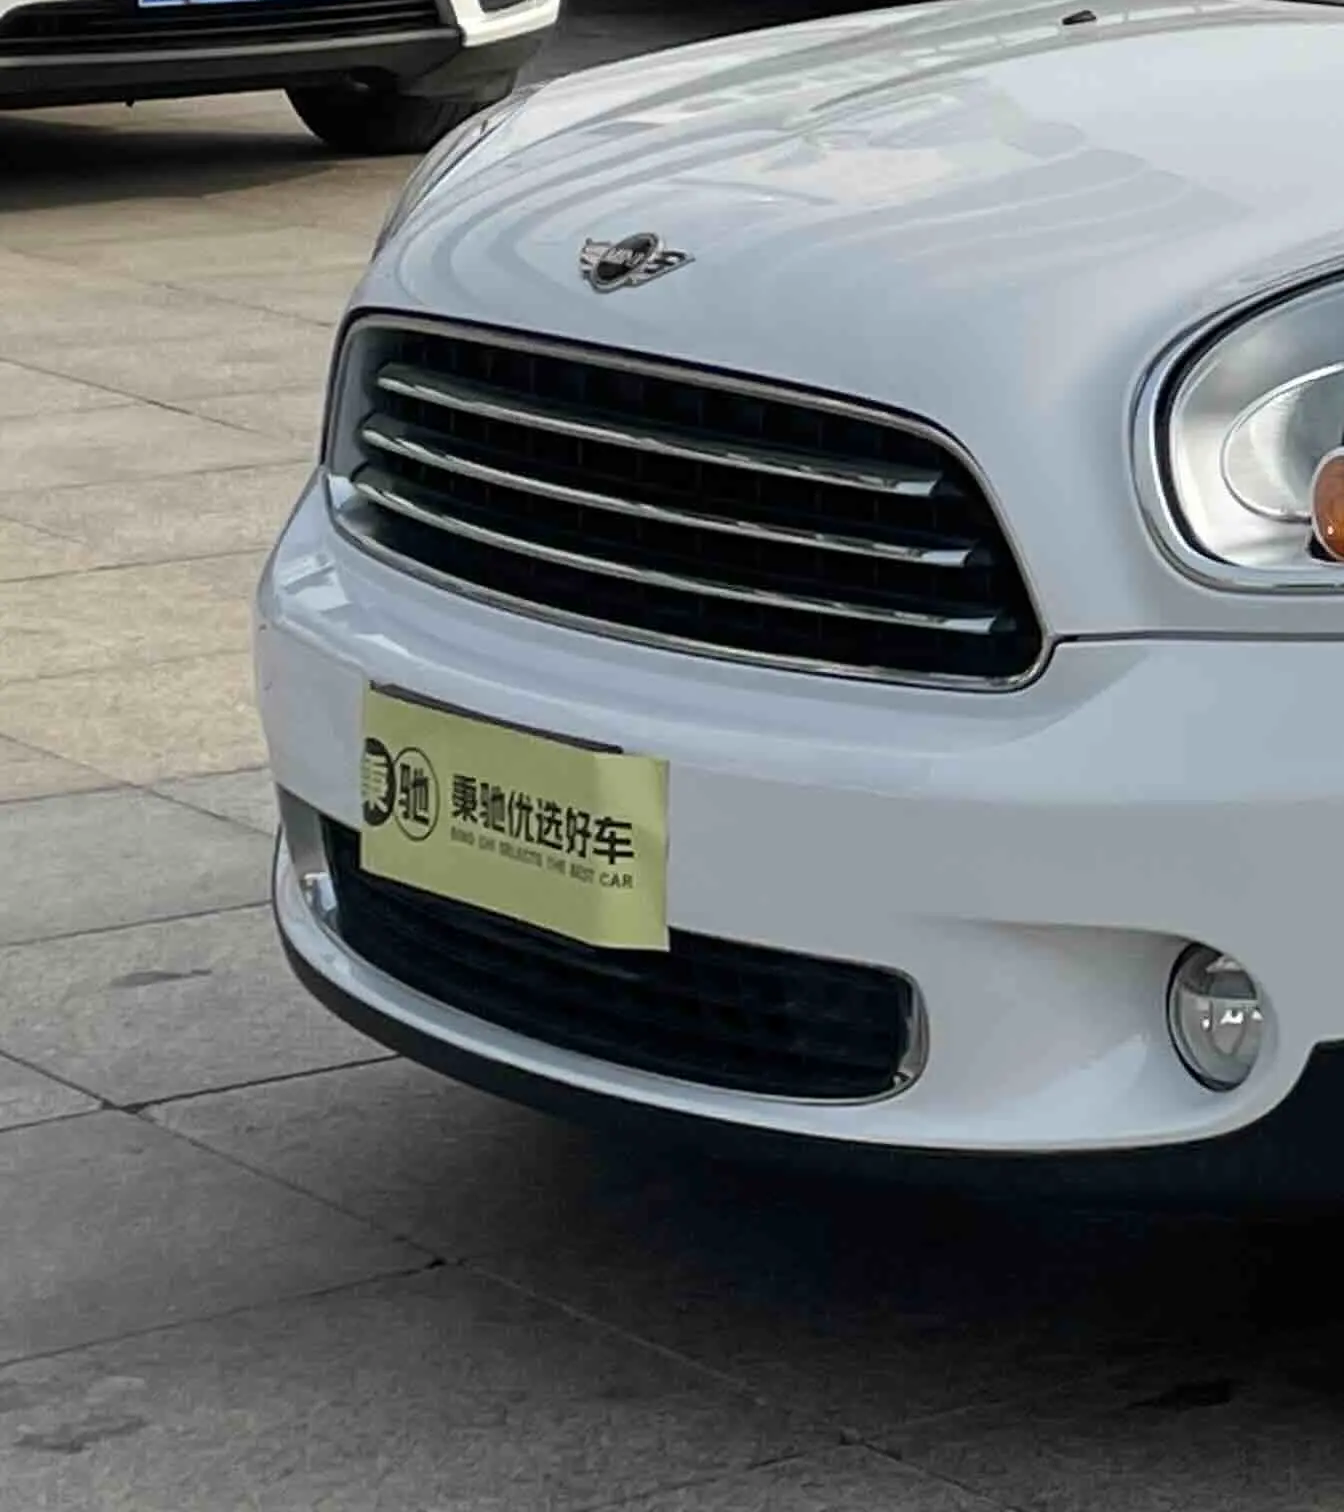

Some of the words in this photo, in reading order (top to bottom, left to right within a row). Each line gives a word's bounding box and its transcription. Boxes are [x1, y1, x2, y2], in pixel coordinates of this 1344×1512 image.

[452, 774, 634, 864] 秉驰优选好车
[599, 871, 633, 888] CAR
